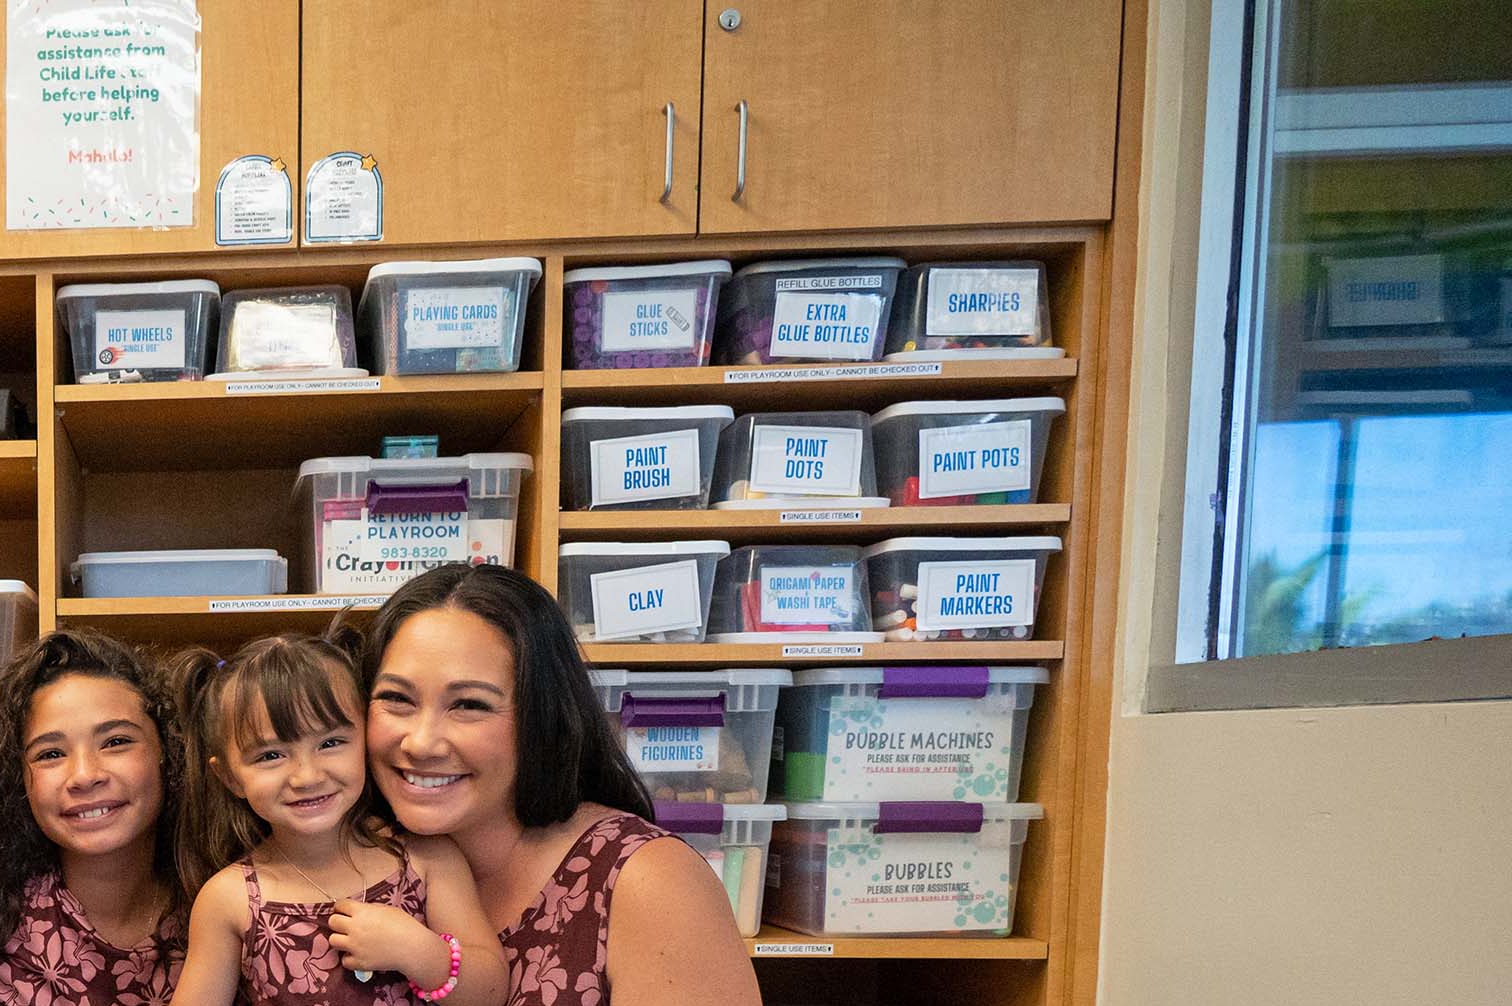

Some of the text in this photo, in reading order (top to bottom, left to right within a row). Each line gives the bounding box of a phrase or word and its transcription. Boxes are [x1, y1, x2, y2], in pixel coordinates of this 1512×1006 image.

[37, 43, 165, 60] assistance from
[40, 66, 80, 81] Child
[85, 65, 116, 79] Life
[42, 85, 159, 103] before helping
[777, 277, 880, 288] REFILL GLUE BOTTLES
[949, 292, 1020, 312] SHARPIES
[413, 304, 497, 320] PLAYING CARDS
[636, 303, 662, 319] GLUE
[807, 303, 846, 321] EXTRA
[108, 327, 172, 342] HOT WHEELS
[630, 321, 668, 336] STICKS
[778, 324, 869, 343] GLUE BOTTLES
[751, 372, 792, 380] PLAYROOM
[836, 368, 867, 376] CANNOT
[880, 366, 918, 374] CHECKED
[786, 438, 828, 457] PAINT
[626, 446, 667, 468] PAINT
[934, 447, 1019, 472] PAINT POTS
[785, 460, 824, 480] DOTS
[624, 468, 670, 490] BRUSH
[368, 512, 461, 523] RETURN TO
[815, 512, 831, 520] USE
[832, 512, 855, 520] ITEMS
[368, 525, 460, 540] PLAYROOM
[381, 547, 447, 559] 983-8320
[769, 577, 845, 590] ORIGAMI PAPER
[957, 573, 1001, 593] PAINT
[629, 589, 664, 612] CLAY
[777, 596, 837, 609] WASHI TAPE
[941, 595, 1013, 616] MARKERS
[817, 646, 833, 654] USE
[834, 646, 857, 654] ITEMS
[648, 727, 699, 742] WOODEN
[845, 732, 994, 750] BUBBLE MACHINES
[641, 745, 704, 761] FIGURINES
[867, 753, 971, 764] PLEASE ASK FOR ASSISTANCE
[885, 862, 953, 881] BUBBLES
[866, 882, 970, 895] PLEASE ASK FOR ASSISTANCE
[761, 945, 787, 953] SINGLE
